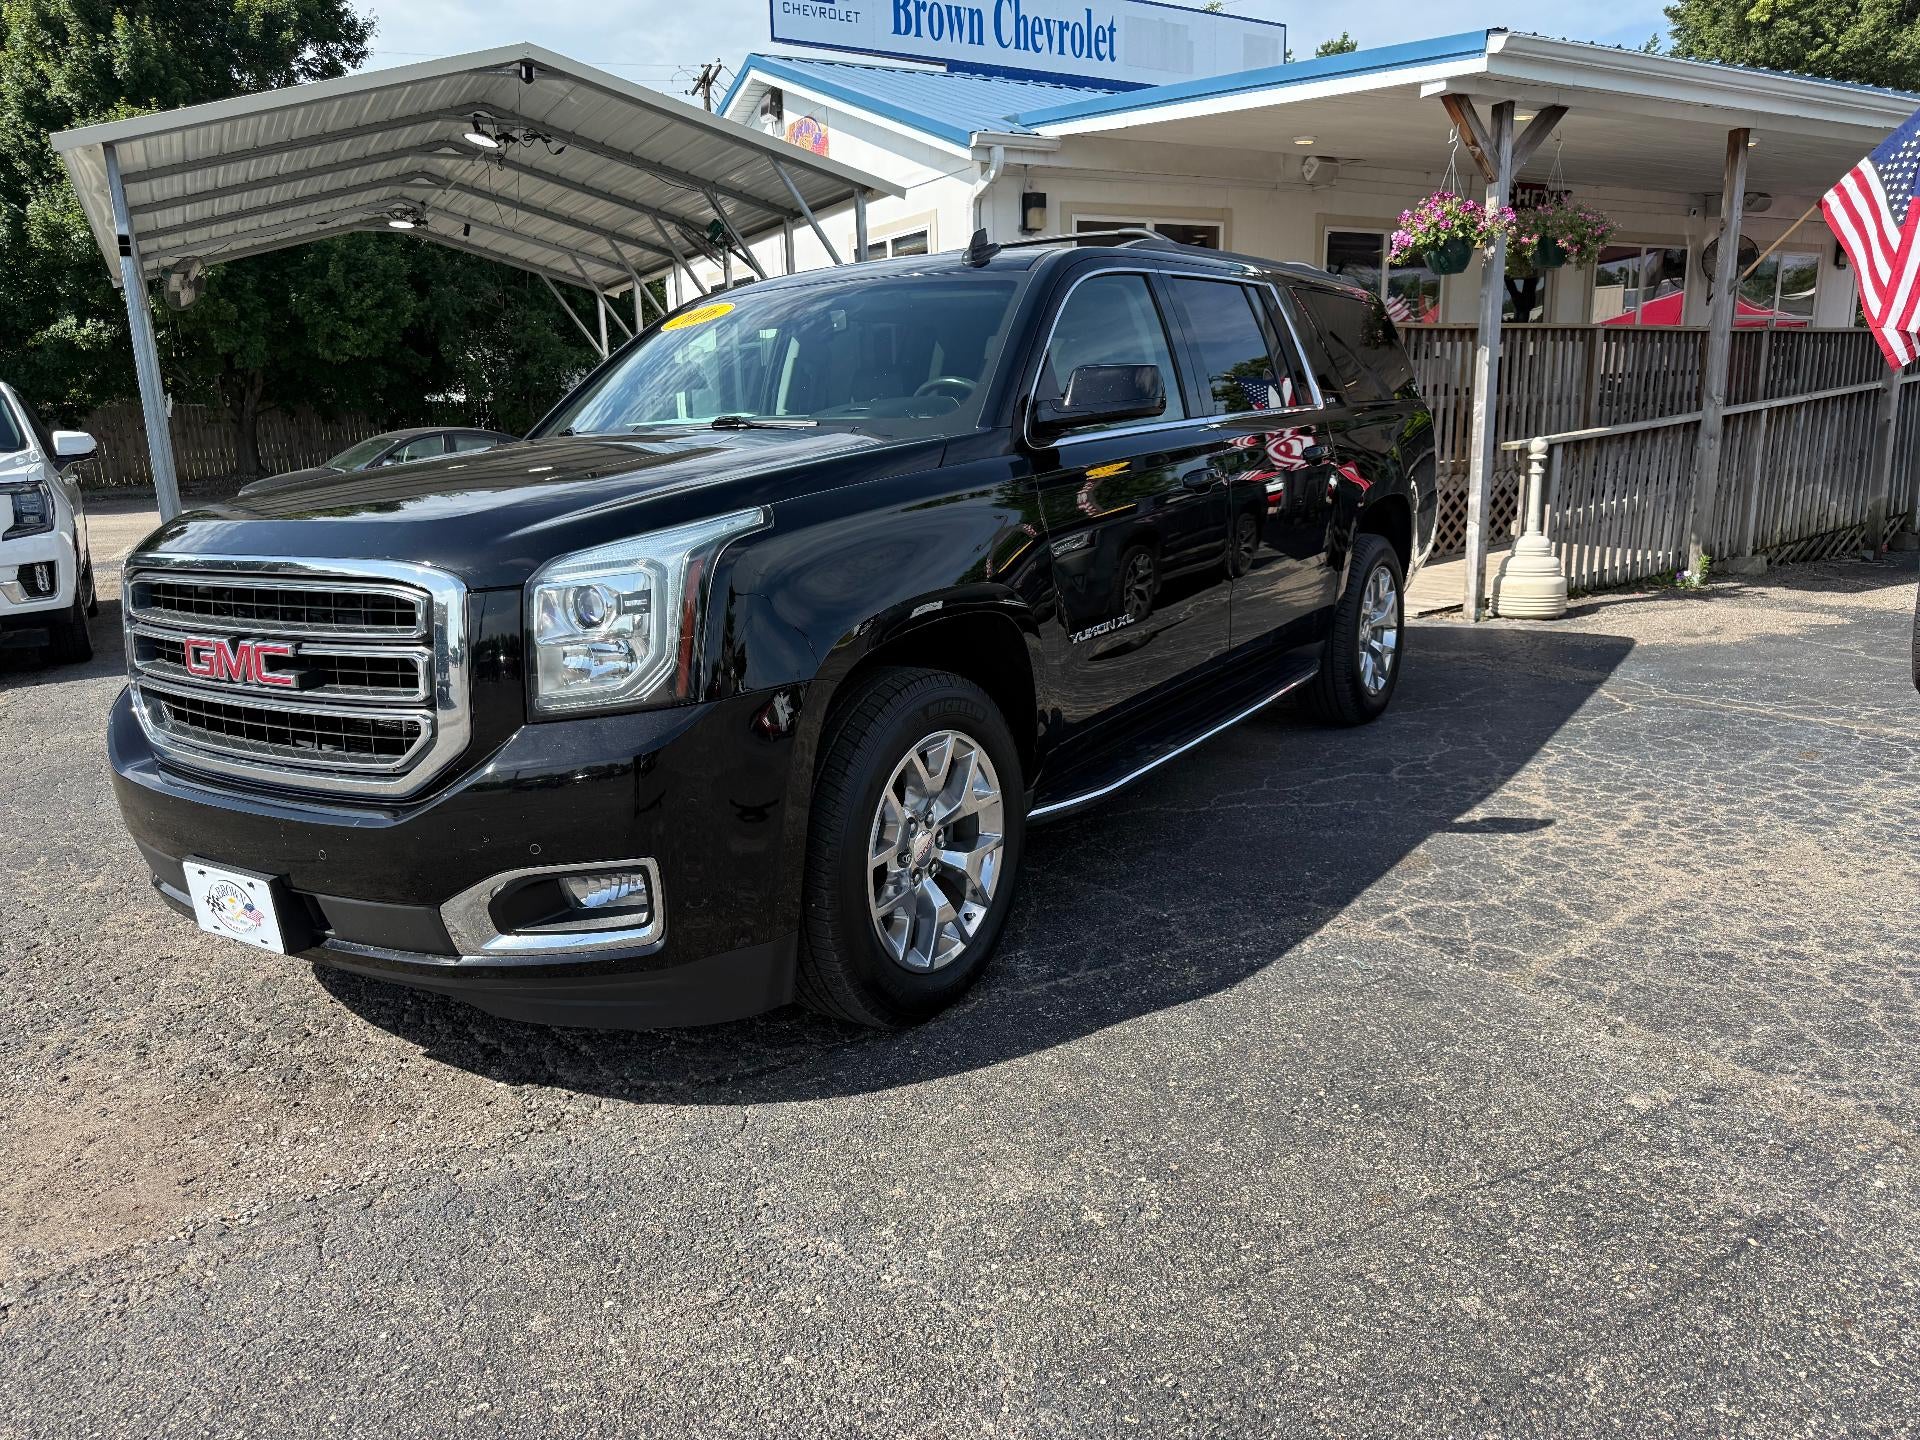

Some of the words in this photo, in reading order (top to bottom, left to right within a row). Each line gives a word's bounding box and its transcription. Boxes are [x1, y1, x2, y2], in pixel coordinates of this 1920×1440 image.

[782, 2, 860, 23] CHEVROLET
[891, 0, 985, 46] Brown
[993, 0, 1117, 62] Chevrolet
[1069, 618, 1115, 644] YUKON
[1117, 613, 1134, 629] XL
[184, 636, 298, 688] GMC
